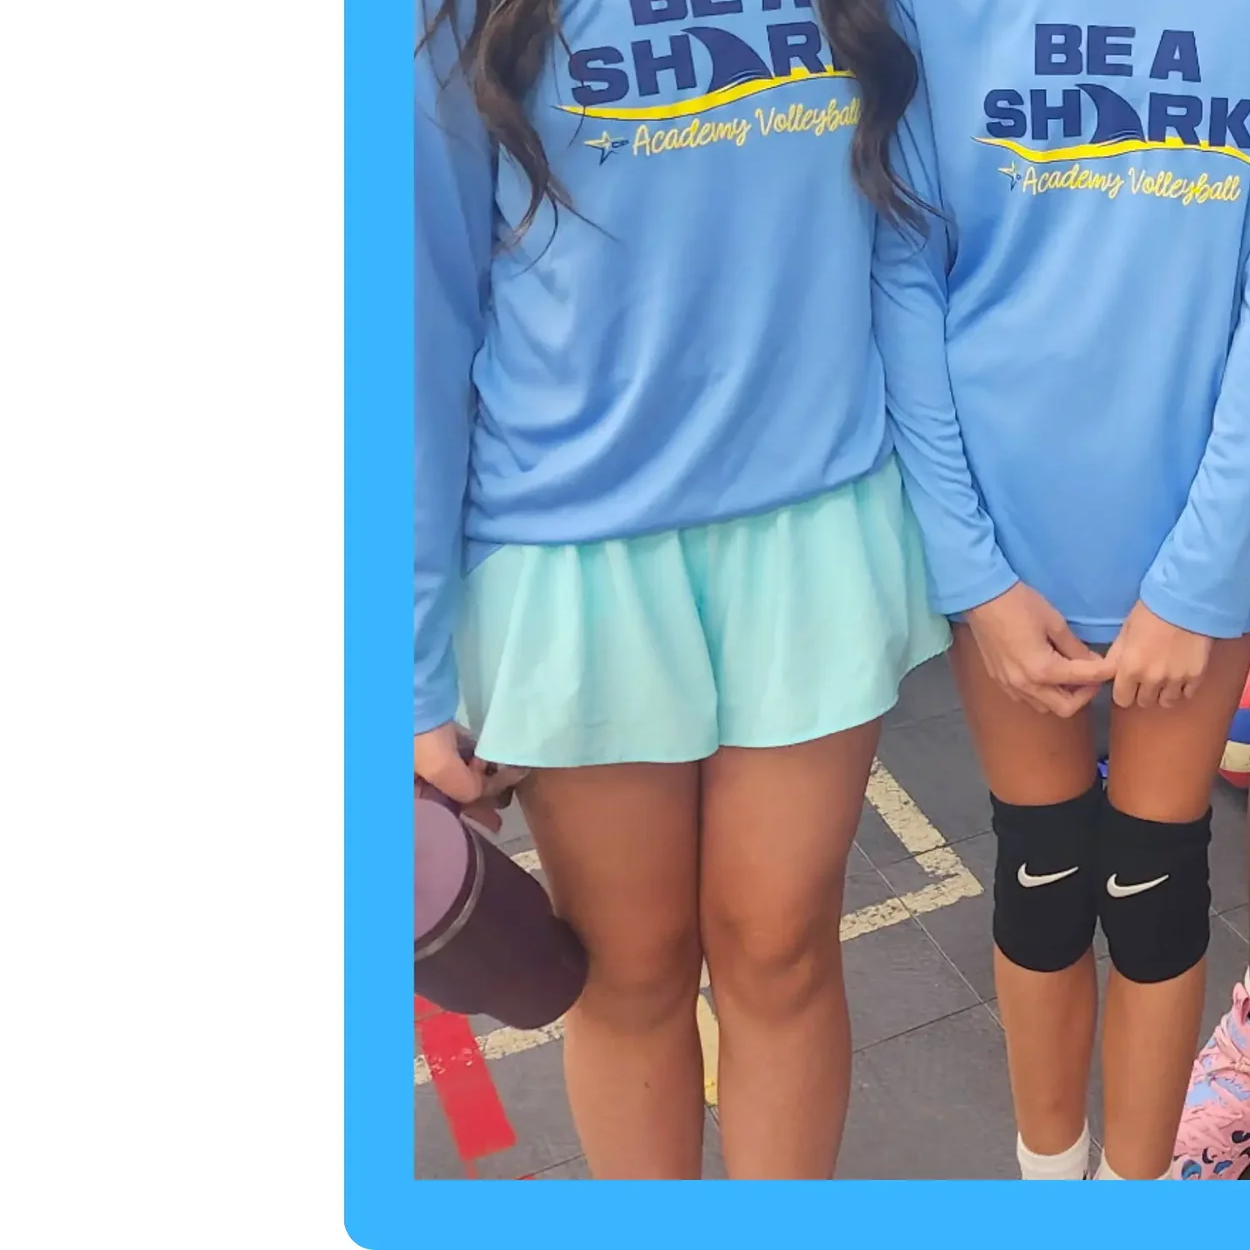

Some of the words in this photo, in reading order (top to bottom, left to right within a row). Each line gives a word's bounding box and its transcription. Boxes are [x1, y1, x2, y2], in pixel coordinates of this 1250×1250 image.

[568, 20, 837, 107] SHAR
[1034, 23, 1136, 77] BE
[1149, 29, 1202, 83] A
[631, 117, 752, 157] Academy
[1021, 163, 1125, 198] Academy
[1127, 166, 1242, 206] Volleyball
